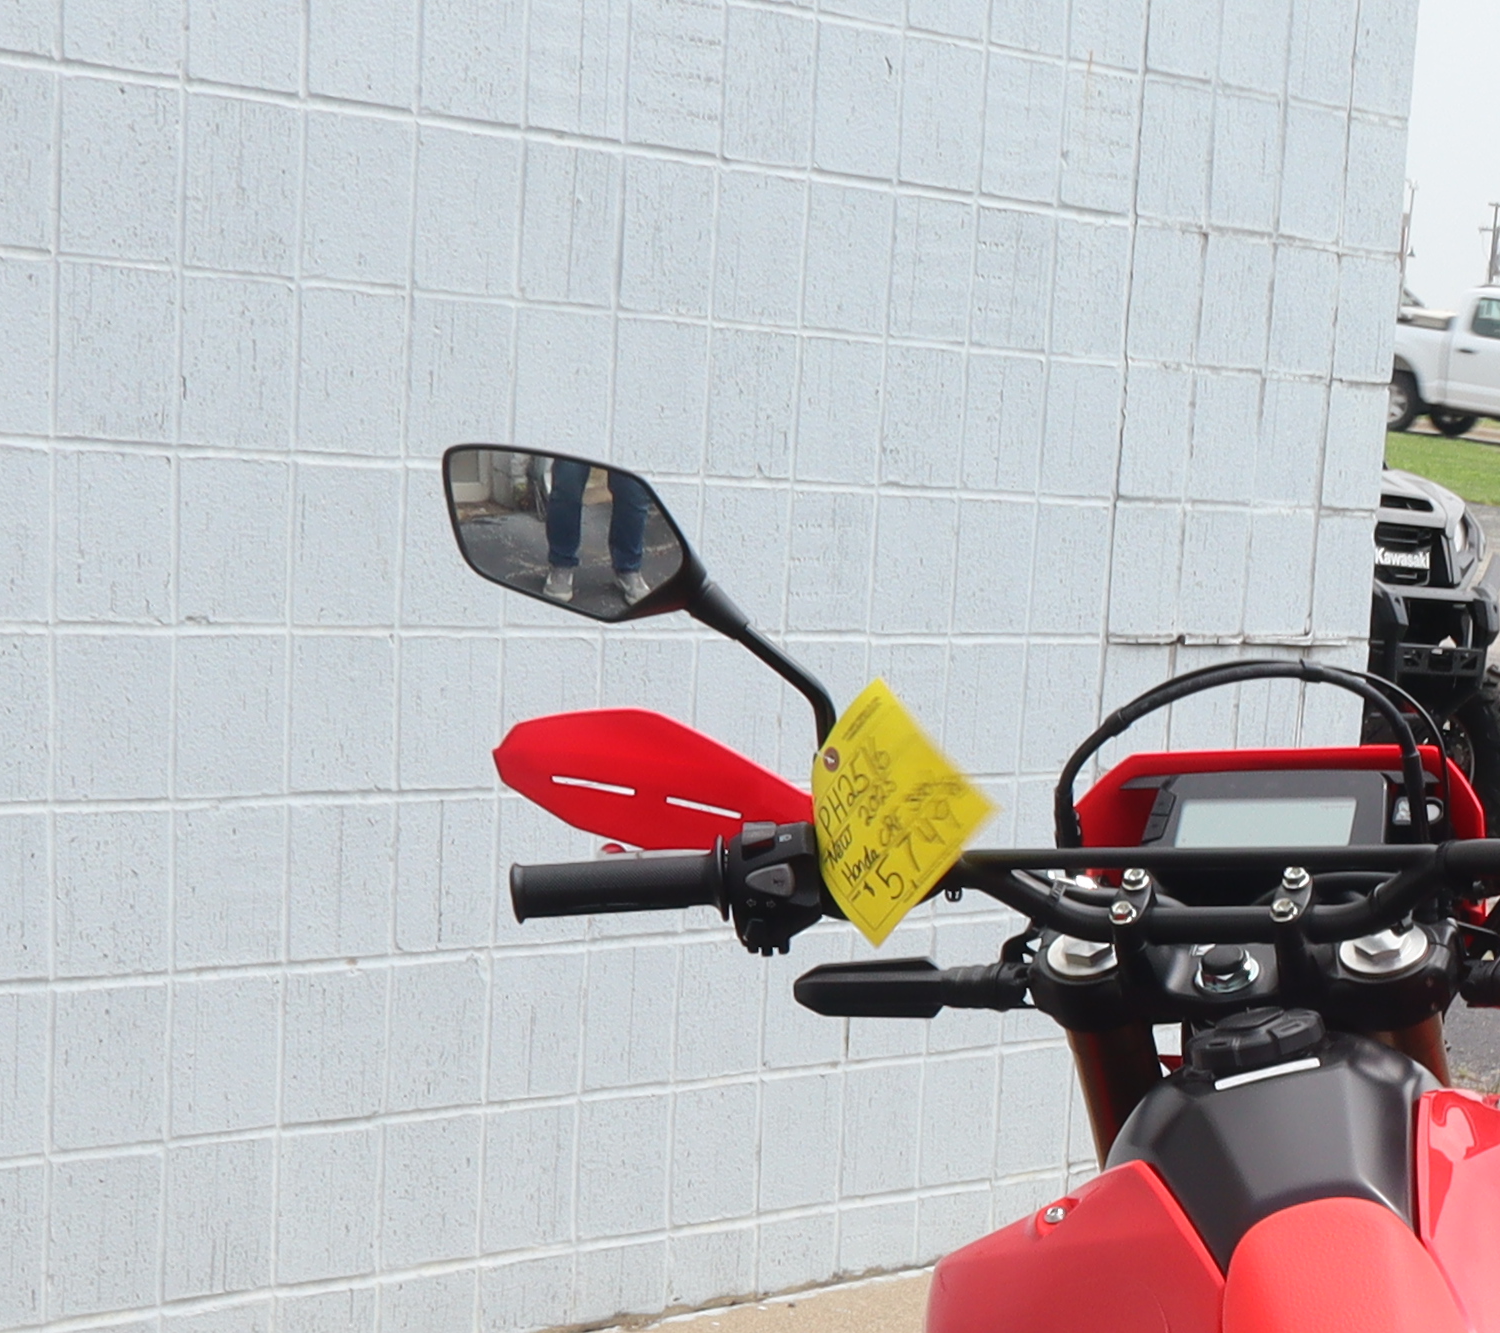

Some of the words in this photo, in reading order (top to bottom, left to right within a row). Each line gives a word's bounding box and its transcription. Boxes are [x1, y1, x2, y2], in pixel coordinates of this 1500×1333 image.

[1374, 547, 1430, 570] Kawasaki
[824, 825, 853, 870] New
[841, 845, 880, 888] Honda
[879, 806, 902, 848] CRF
